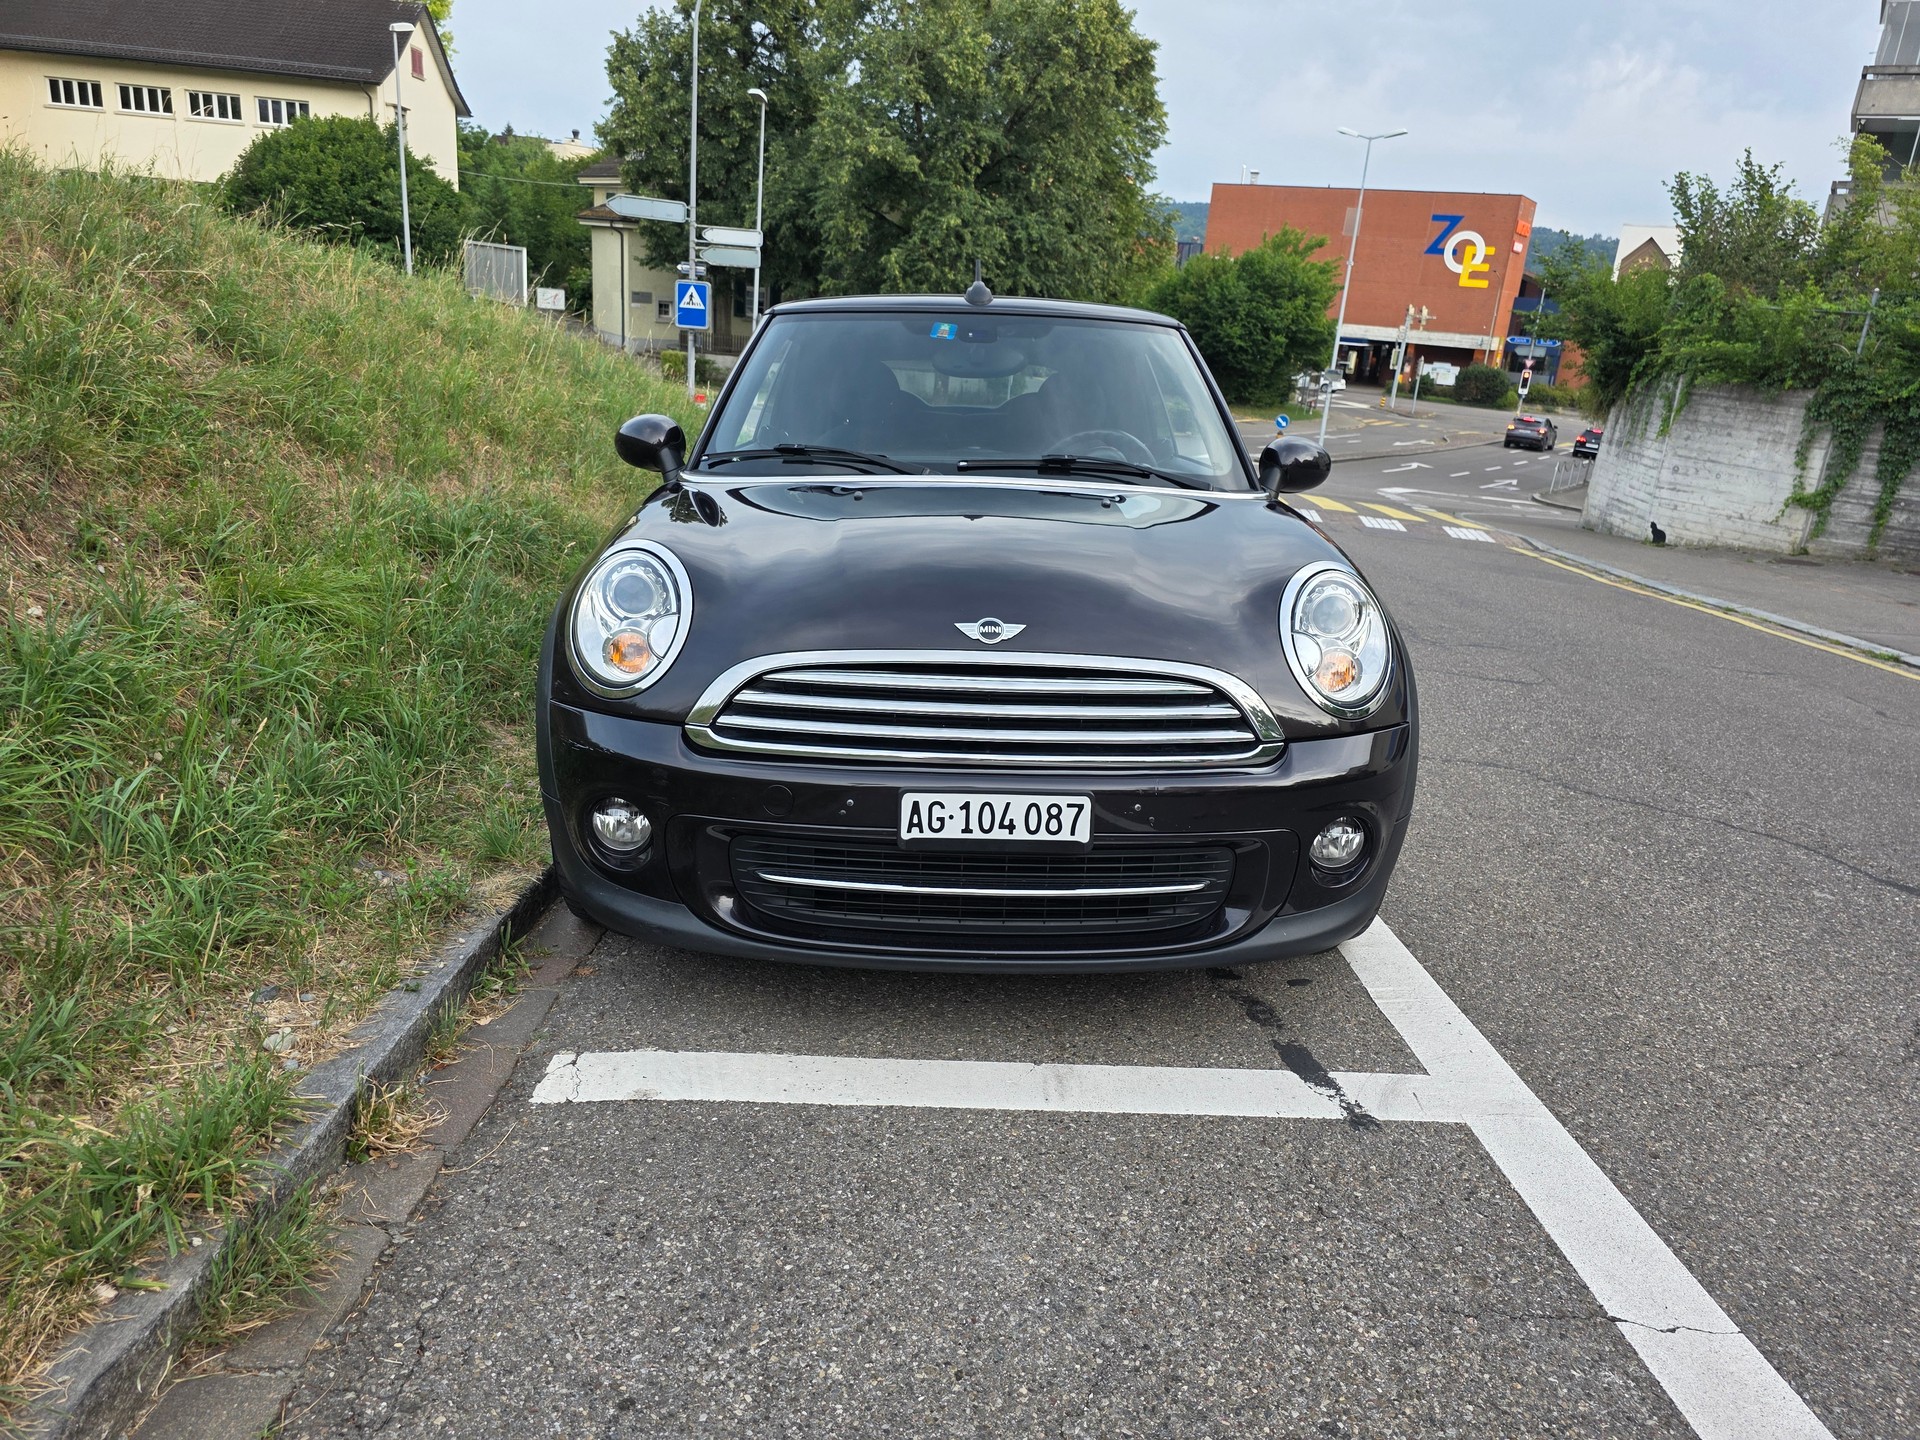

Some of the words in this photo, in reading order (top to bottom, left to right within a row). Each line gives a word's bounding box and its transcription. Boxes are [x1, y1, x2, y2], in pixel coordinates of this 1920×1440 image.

[1423, 213, 1496, 289] ZOE
[979, 625, 1002, 634] MINI
[1024, 802, 1085, 836] 087
